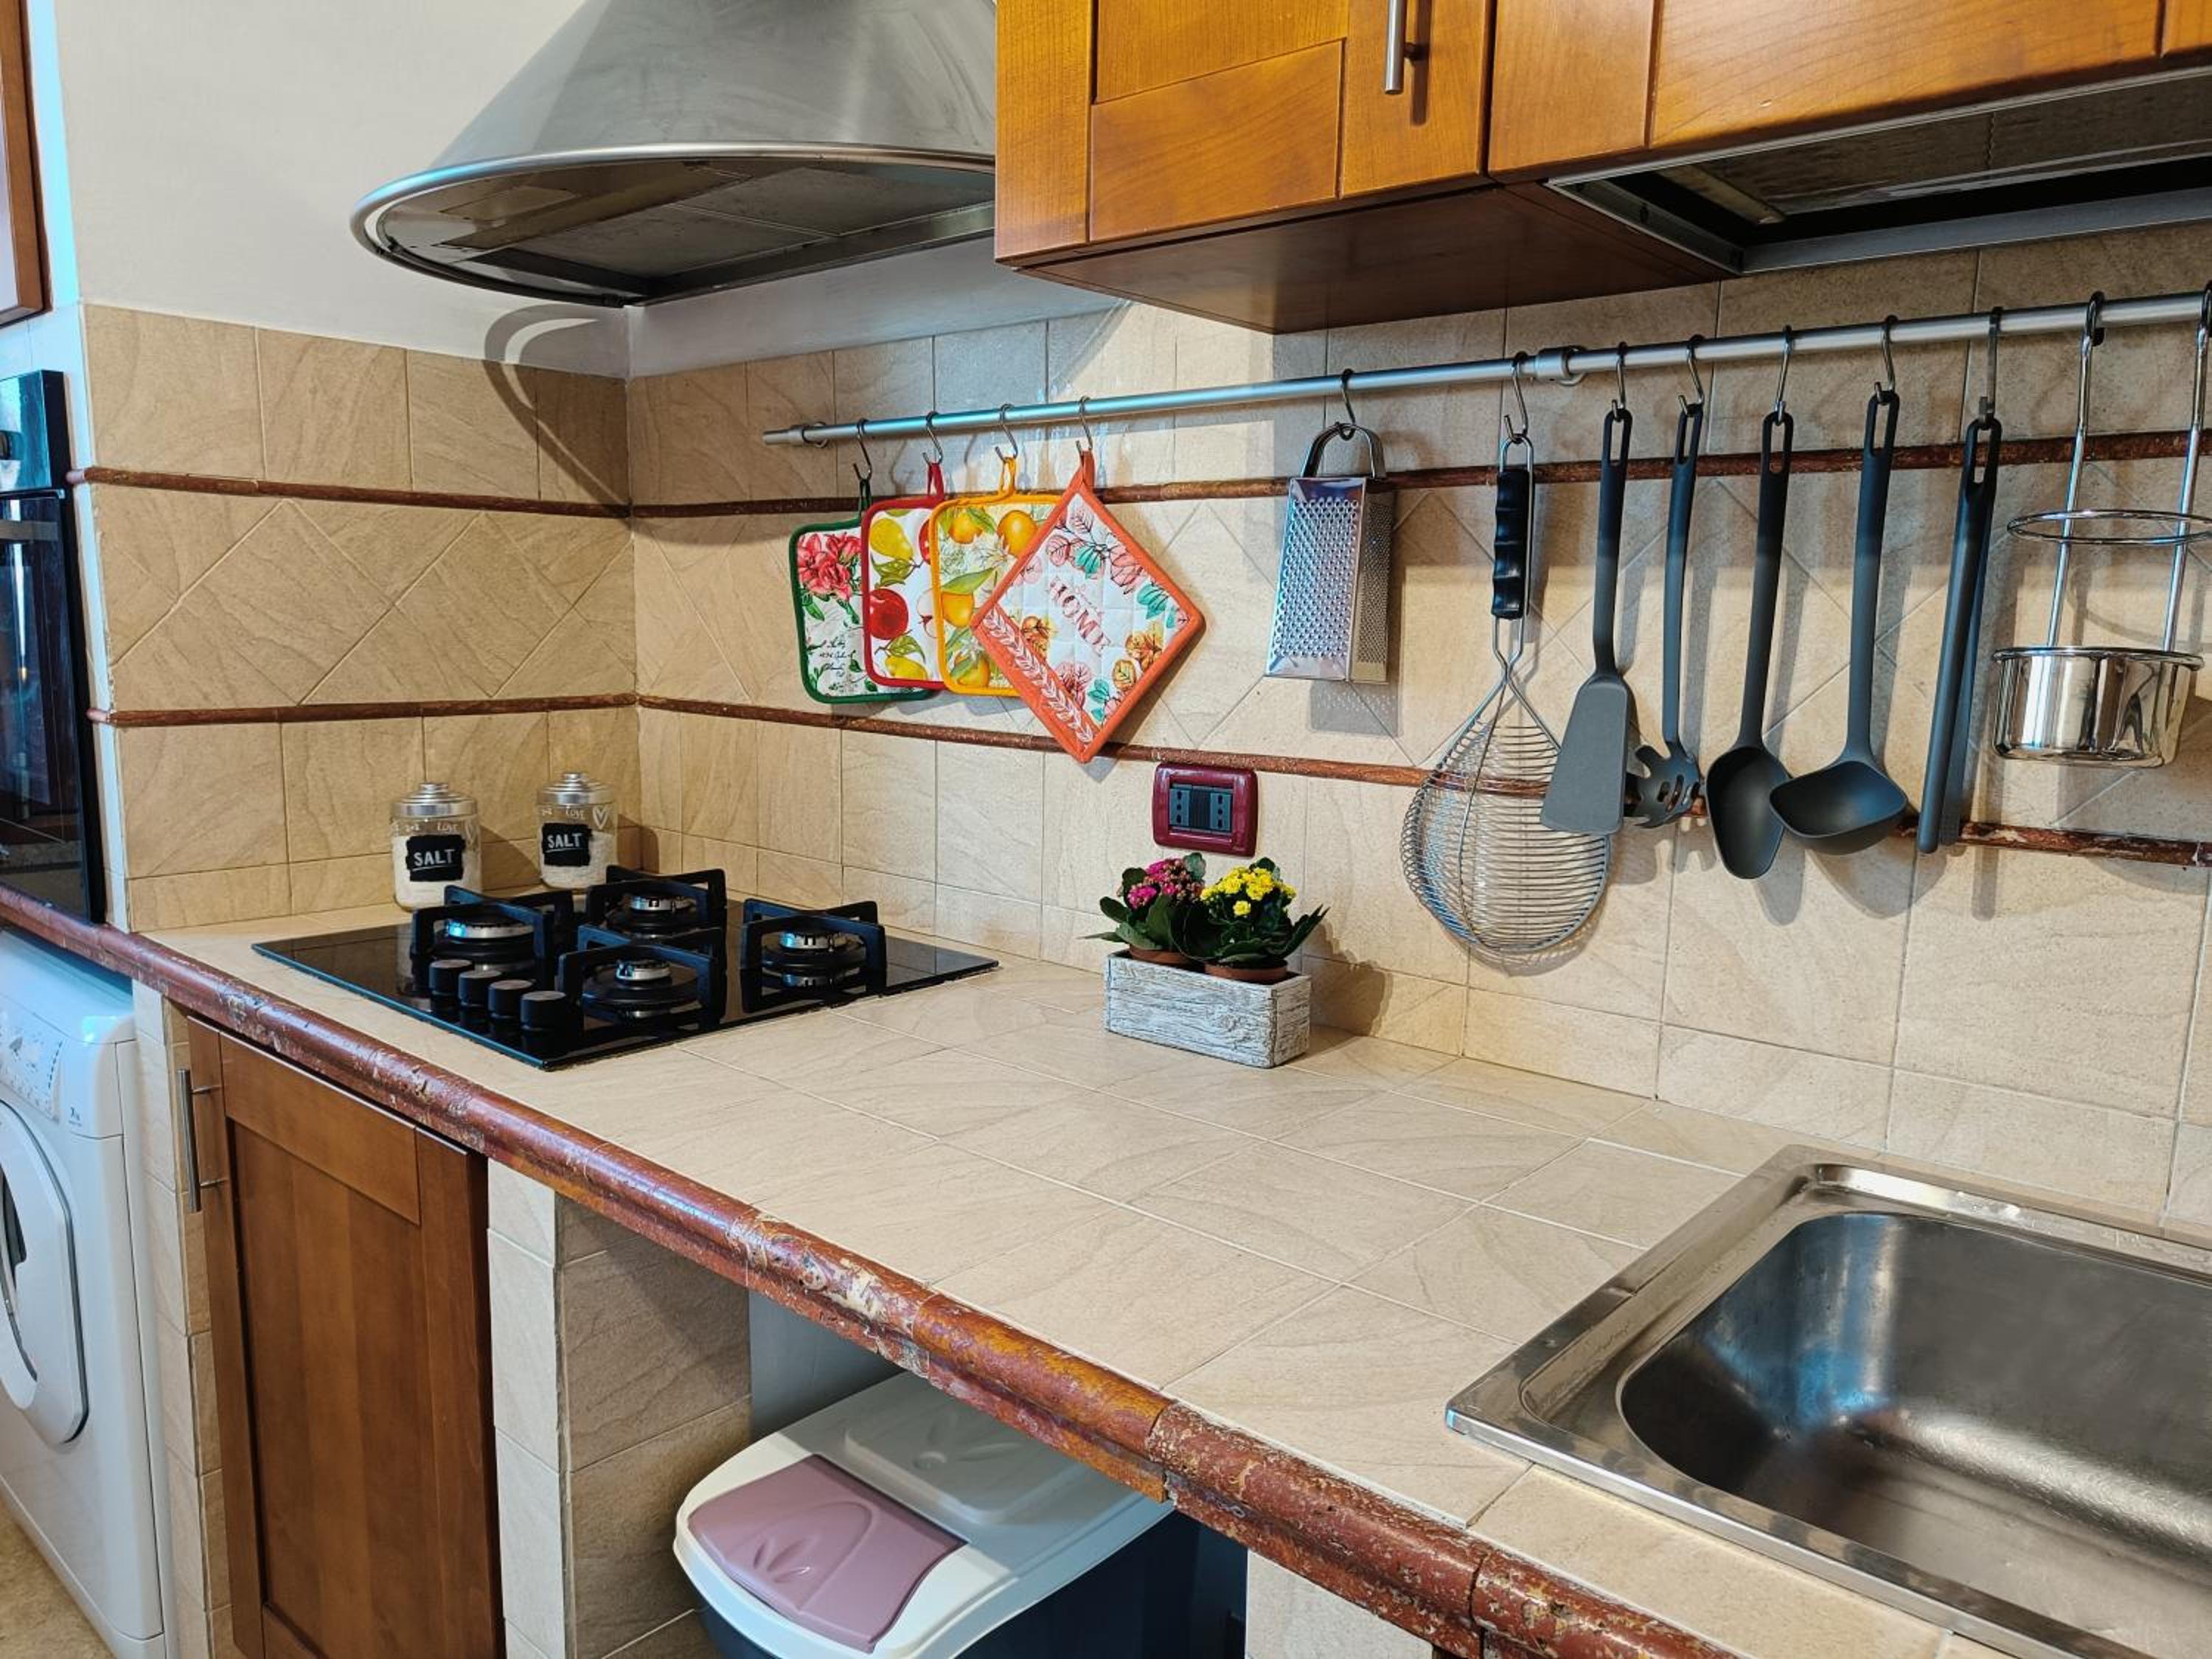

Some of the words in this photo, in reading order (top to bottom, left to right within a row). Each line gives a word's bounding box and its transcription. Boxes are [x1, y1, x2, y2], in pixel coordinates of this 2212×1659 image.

[1048, 580, 1111, 658] HOME
[547, 832, 583, 849] SALT
[413, 849, 456, 866] SALT
